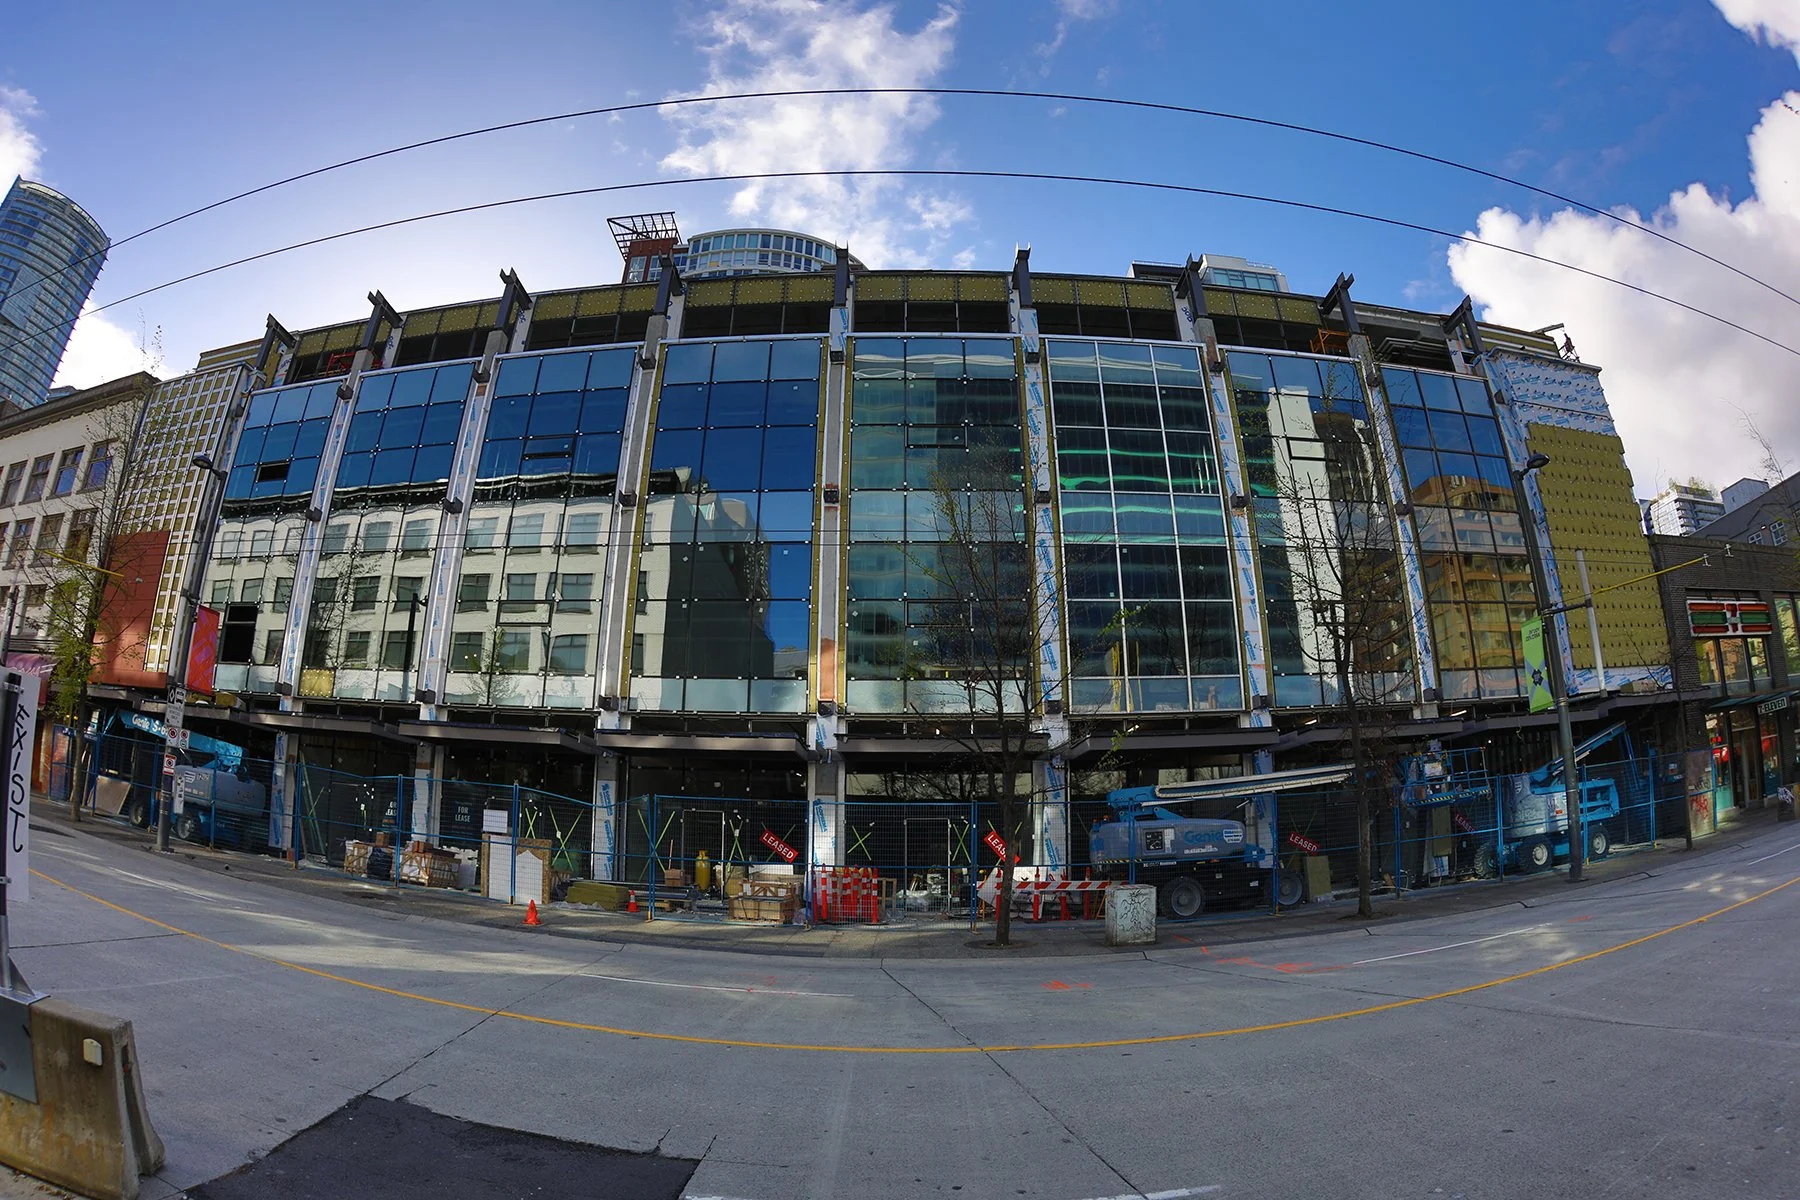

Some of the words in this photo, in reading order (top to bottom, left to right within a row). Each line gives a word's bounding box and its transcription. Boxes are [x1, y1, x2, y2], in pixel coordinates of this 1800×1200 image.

[132, 713, 150, 730] Genie
[9, 704, 30, 853] EXIST
[455, 814, 471, 823] LEASE
[458, 806, 469, 814] FOR
[762, 832, 795, 860] LEASED
[987, 834, 1006, 858] LEAS
[1290, 833, 1318, 852] LEASED
